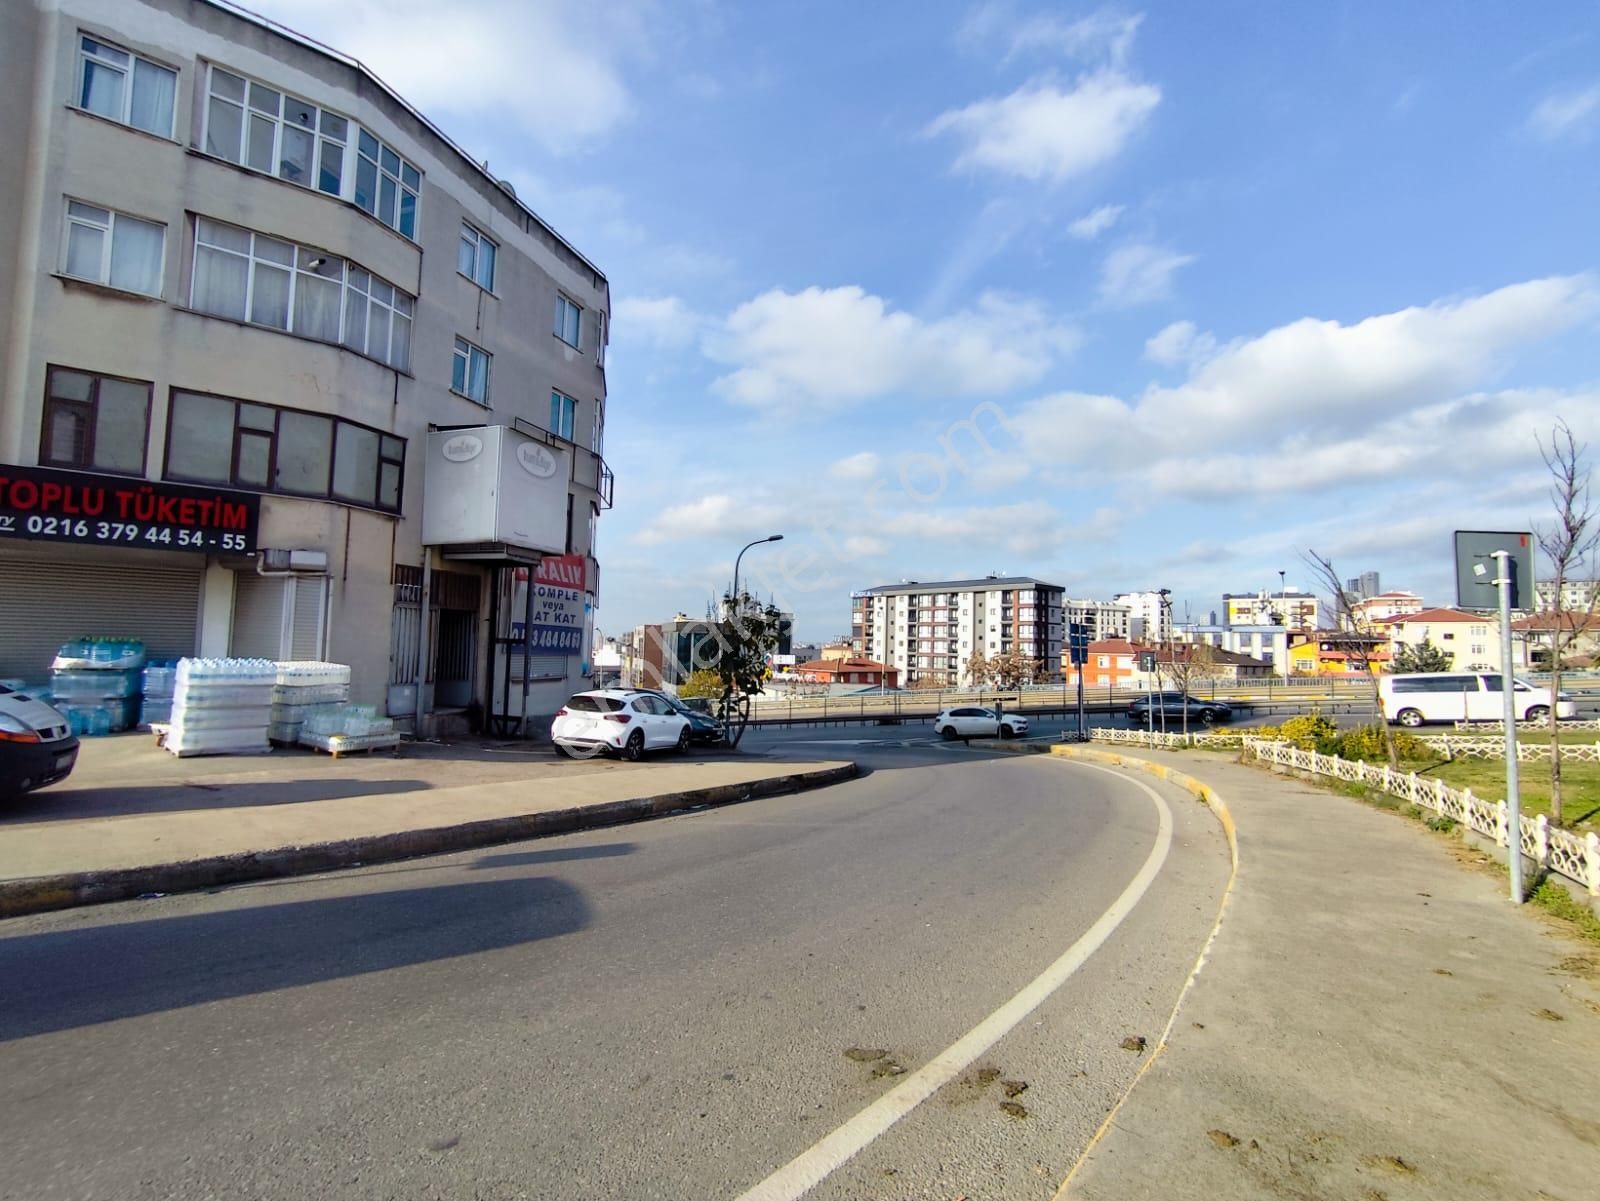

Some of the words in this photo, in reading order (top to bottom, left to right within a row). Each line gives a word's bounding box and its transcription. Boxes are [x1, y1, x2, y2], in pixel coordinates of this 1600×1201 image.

[115, 486, 248, 529] TÜKETİM
[27, 515, 89, 537] 0216
[96, 521, 139, 541] 379
[145, 526, 172, 544] 44
[178, 529, 204, 547] 54
[222, 533, 246, 550] 55
[533, 586, 579, 601] OMPLE
[542, 600, 564, 612] veya
[532, 611, 550, 622] AT
[554, 612, 577, 624] KAT
